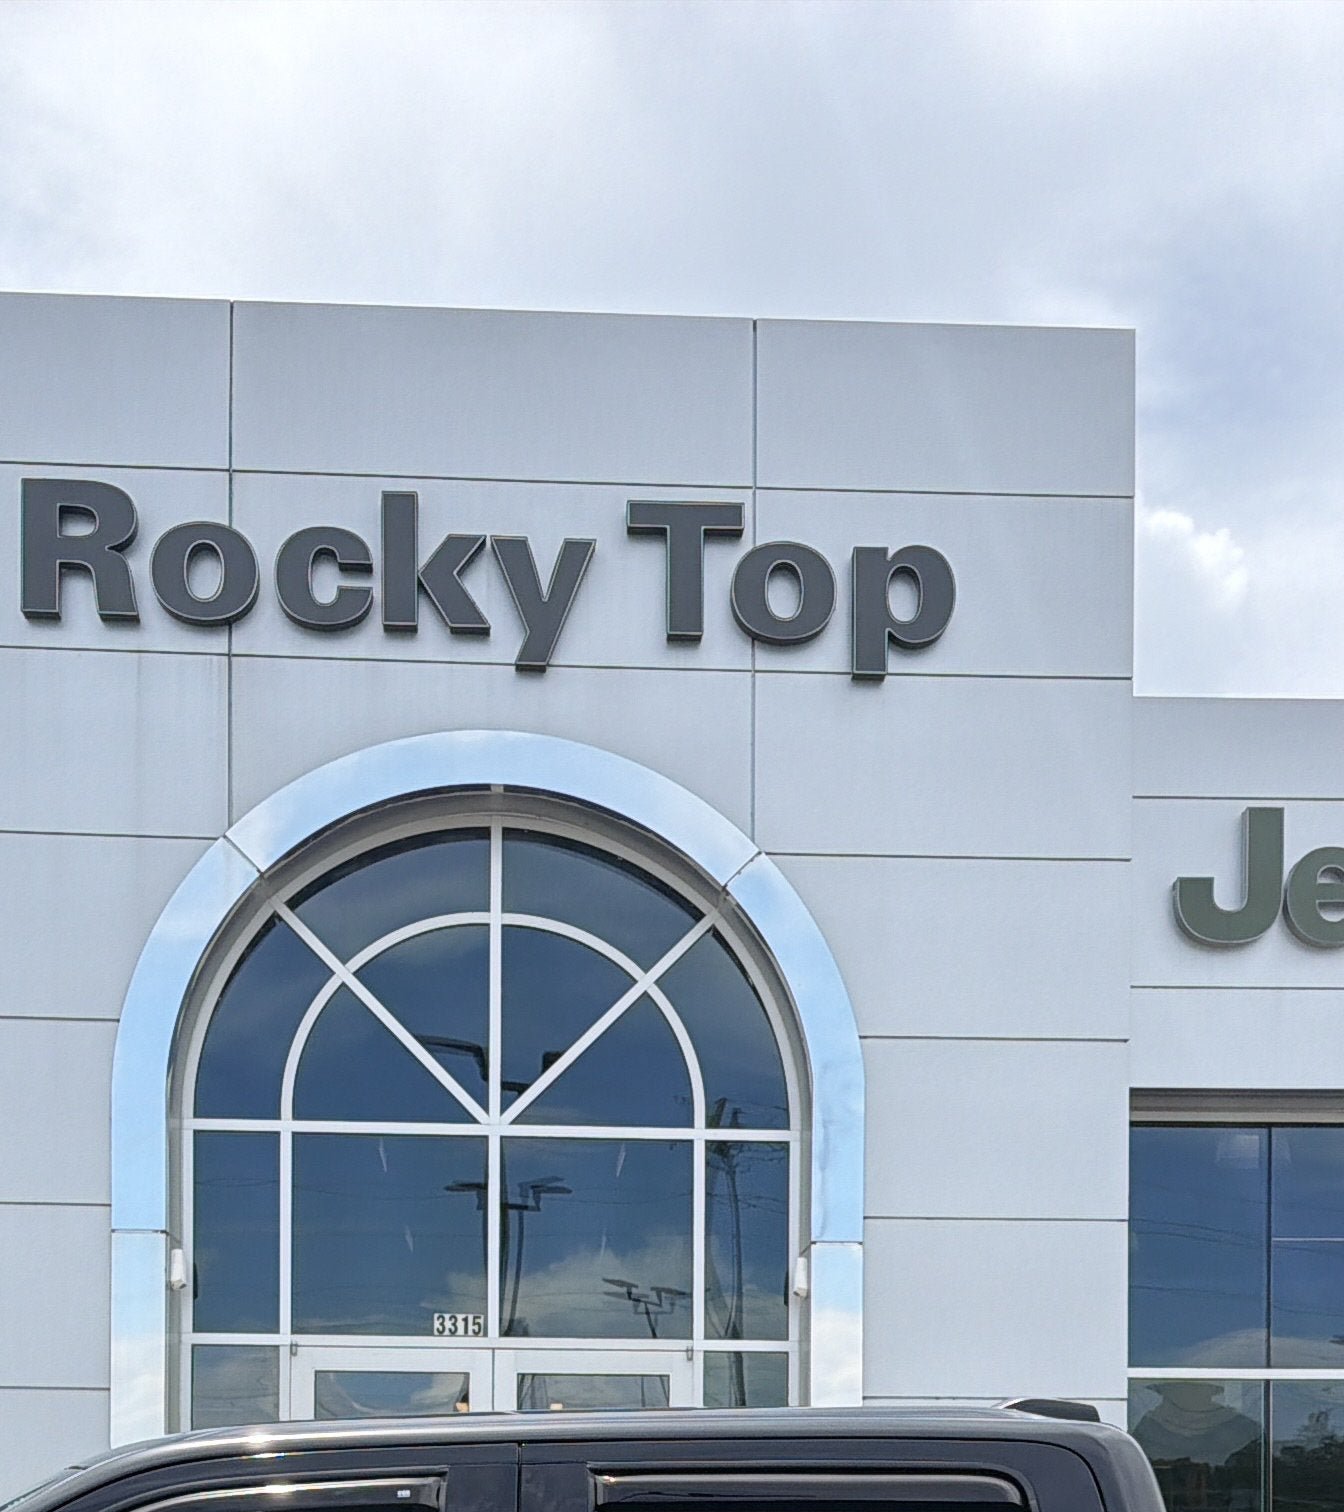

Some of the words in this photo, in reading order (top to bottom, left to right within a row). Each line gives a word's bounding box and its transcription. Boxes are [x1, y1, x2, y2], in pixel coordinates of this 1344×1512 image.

[20, 477, 597, 673] Rocky
[625, 499, 957, 682] Top
[435, 1313, 484, 1336] 3315
